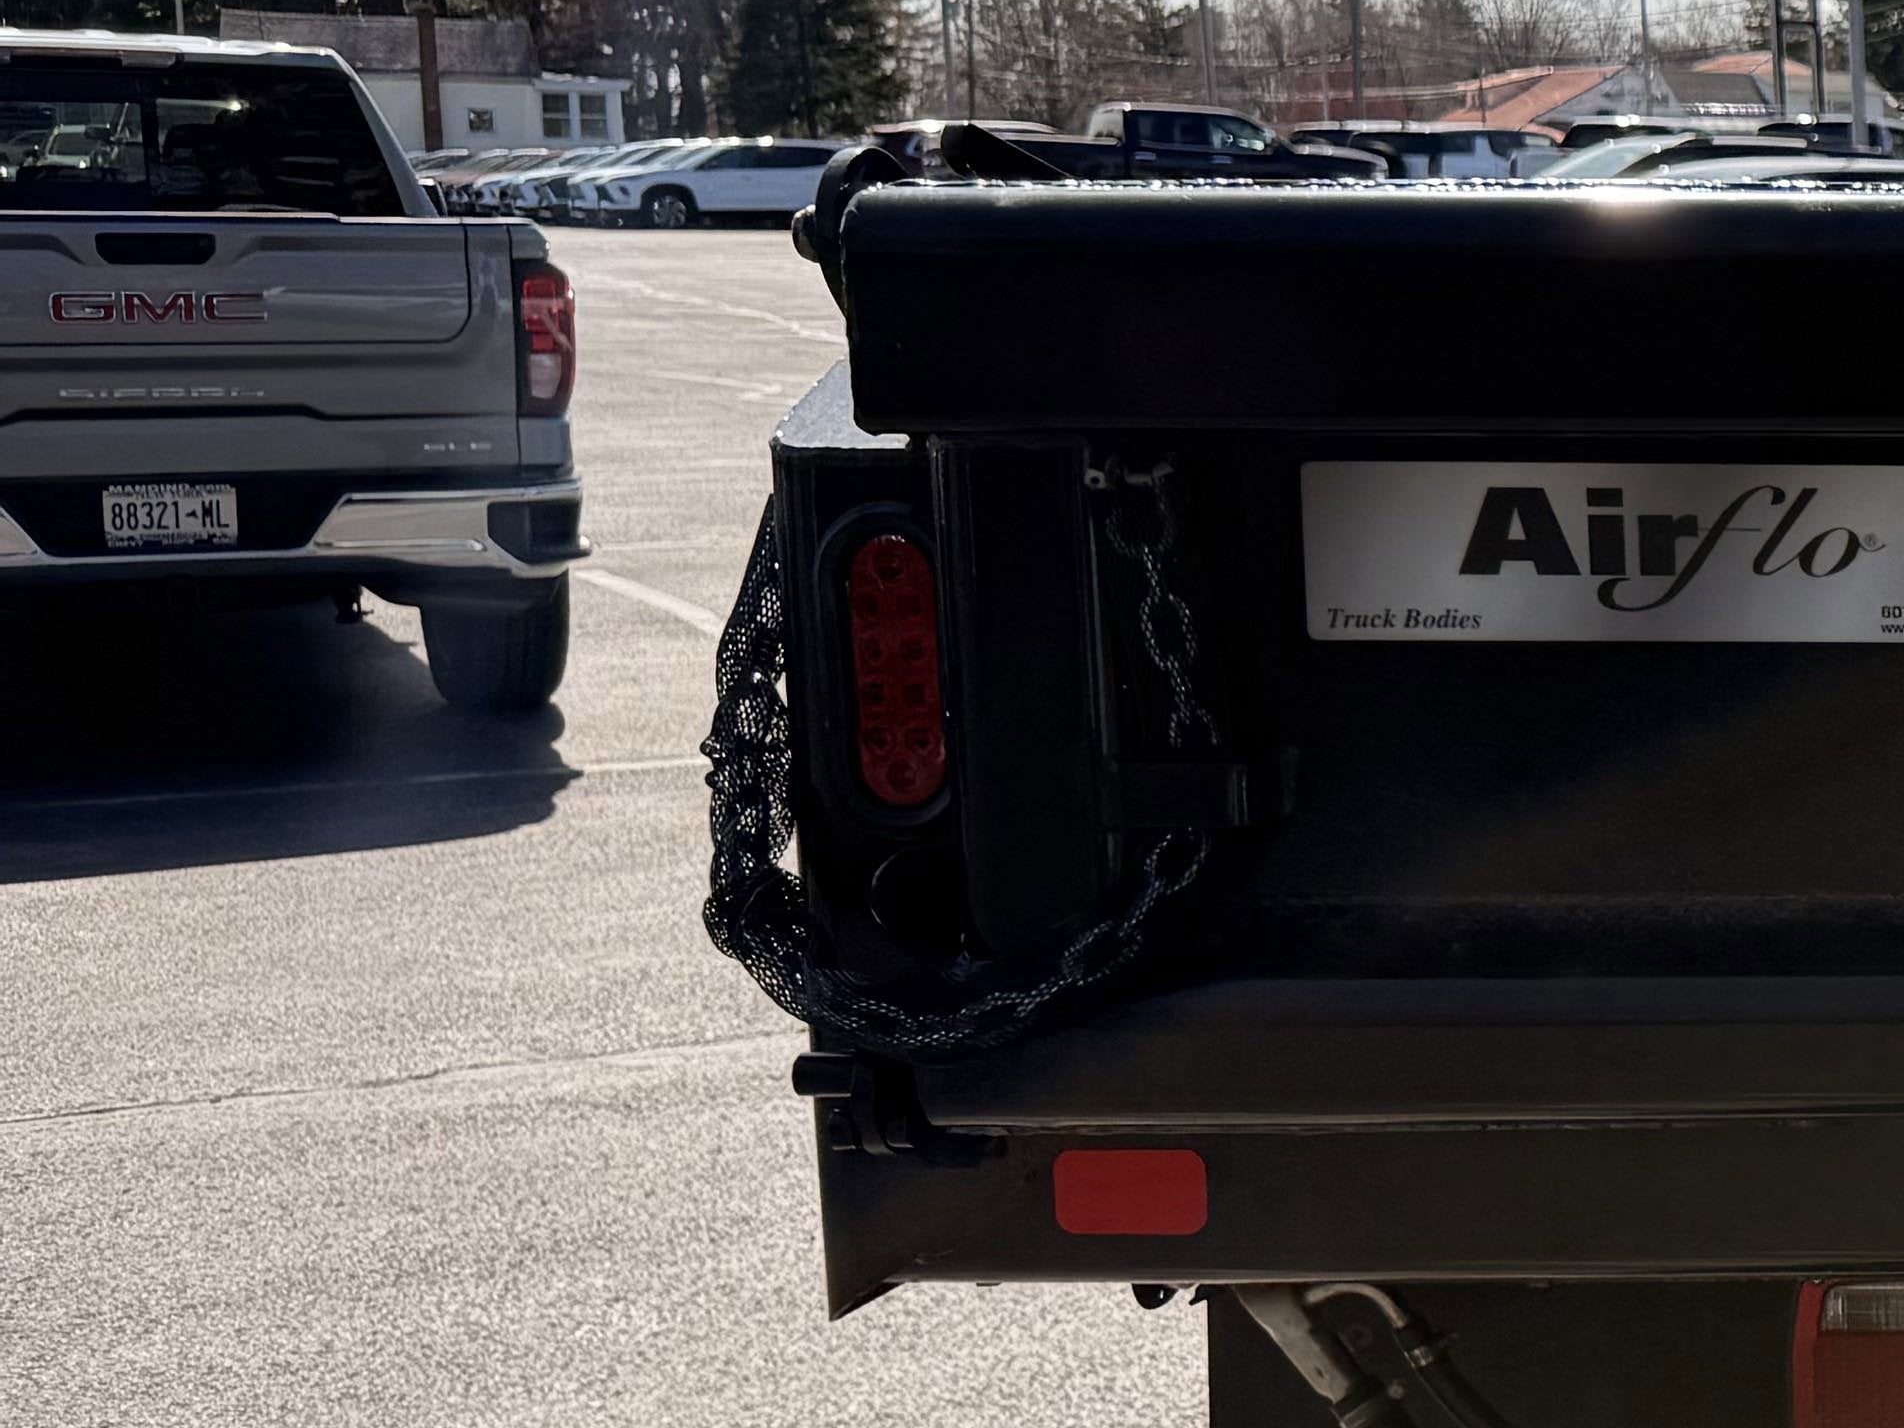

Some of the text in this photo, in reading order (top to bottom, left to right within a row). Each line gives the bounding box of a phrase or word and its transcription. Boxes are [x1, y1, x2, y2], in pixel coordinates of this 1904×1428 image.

[50, 290, 267, 324] GMC
[111, 500, 181, 531] 88321
[1458, 484, 1882, 613] Airflo
[1328, 607, 1483, 629] Truck Bodies
